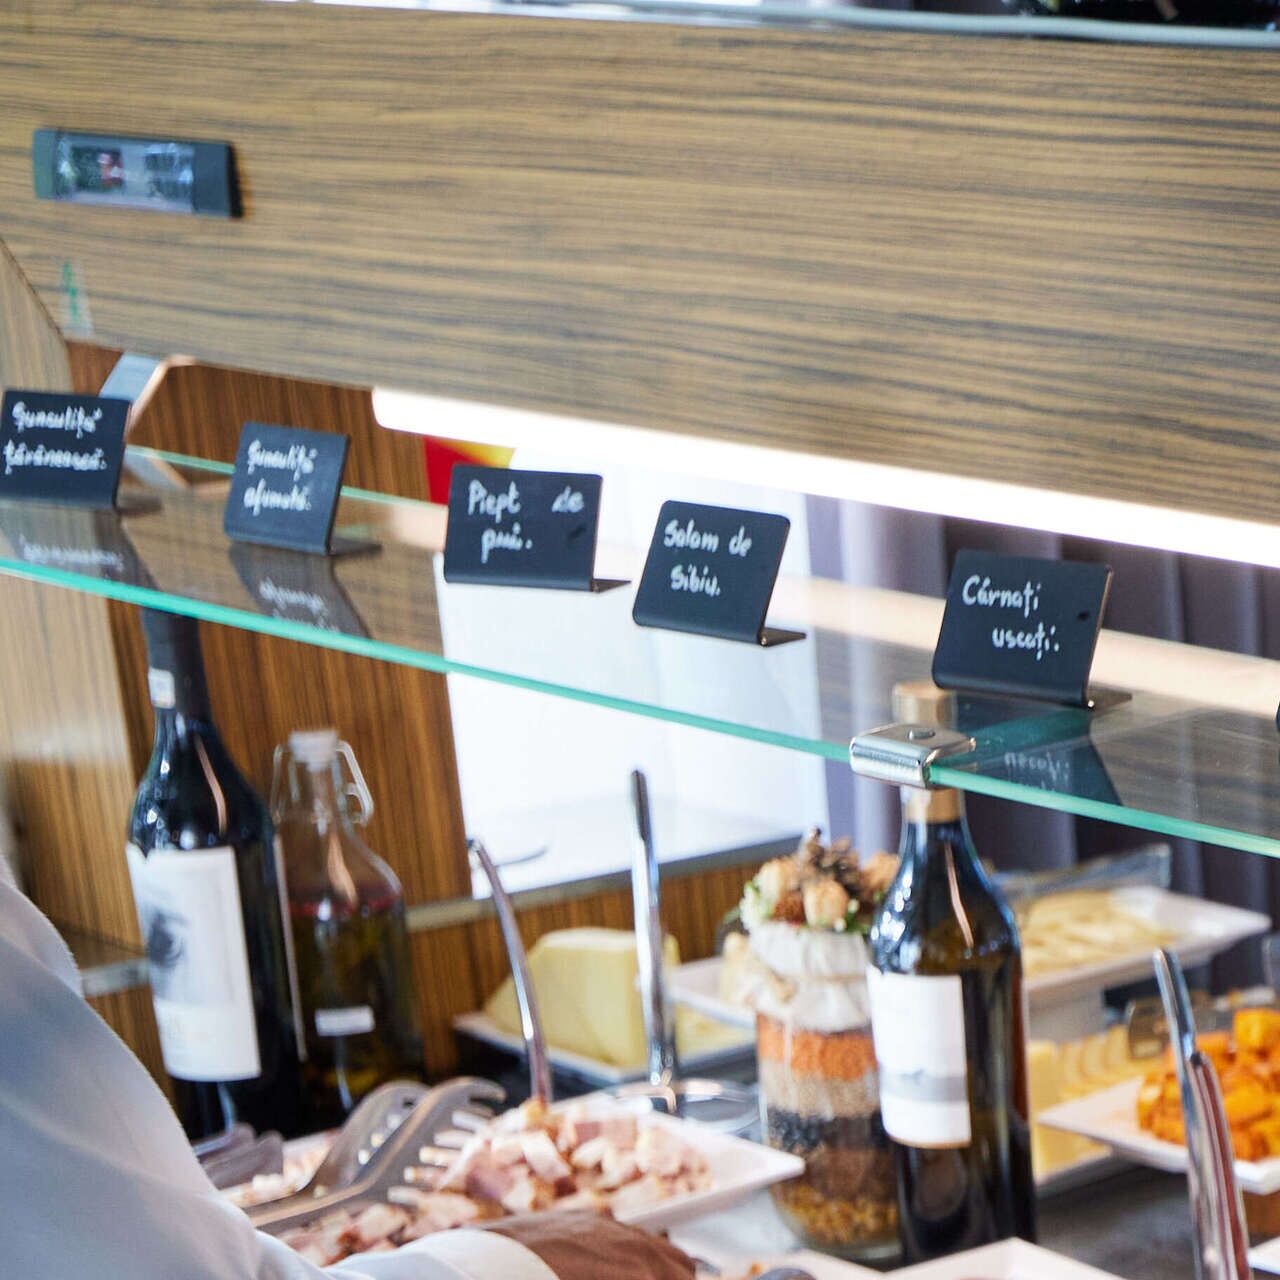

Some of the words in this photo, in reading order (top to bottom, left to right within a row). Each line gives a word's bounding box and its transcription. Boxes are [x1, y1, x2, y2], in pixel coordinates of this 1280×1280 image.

[467, 479, 522, 523] Piept
[551, 486, 585, 513] de
[663, 519, 718, 552] Salam
[728, 526, 752, 557] de
